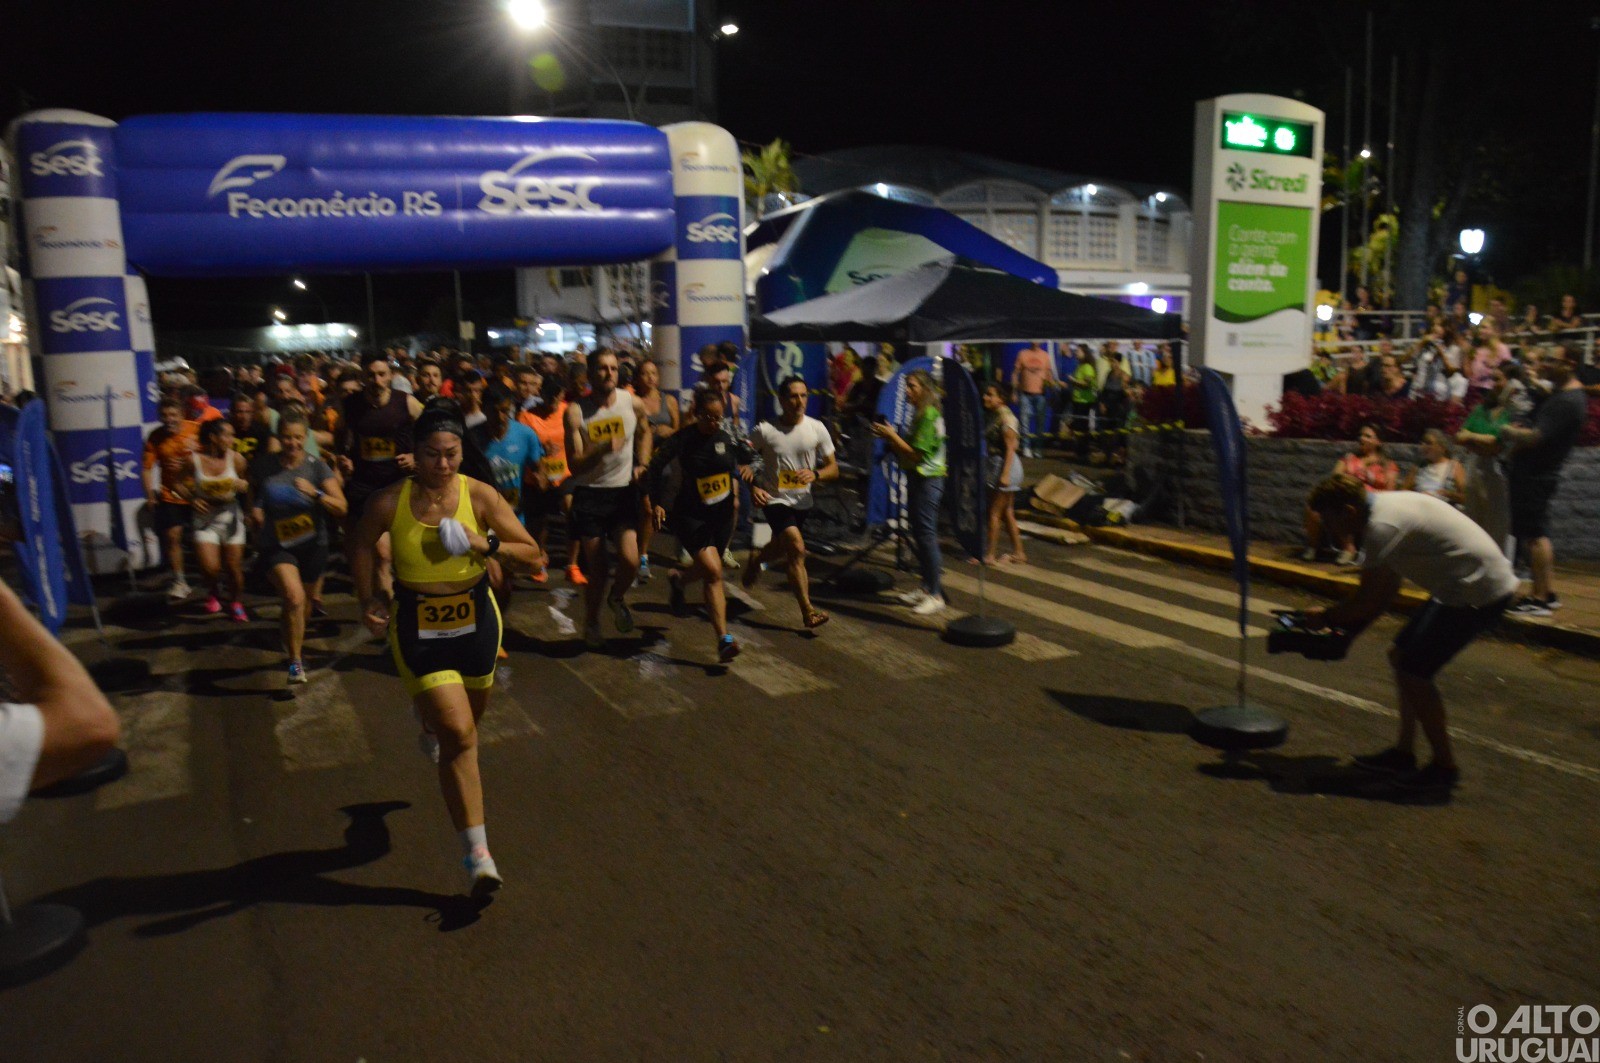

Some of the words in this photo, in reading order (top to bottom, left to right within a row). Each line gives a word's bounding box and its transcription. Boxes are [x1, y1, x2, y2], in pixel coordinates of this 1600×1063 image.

[1249, 168, 1309, 192] Sicredi
[228, 191, 397, 219] Fecomércio
[403, 191, 443, 216] RS
[593, 420, 621, 439] 347
[701, 475, 728, 497] 261
[424, 602, 470, 623] 320
